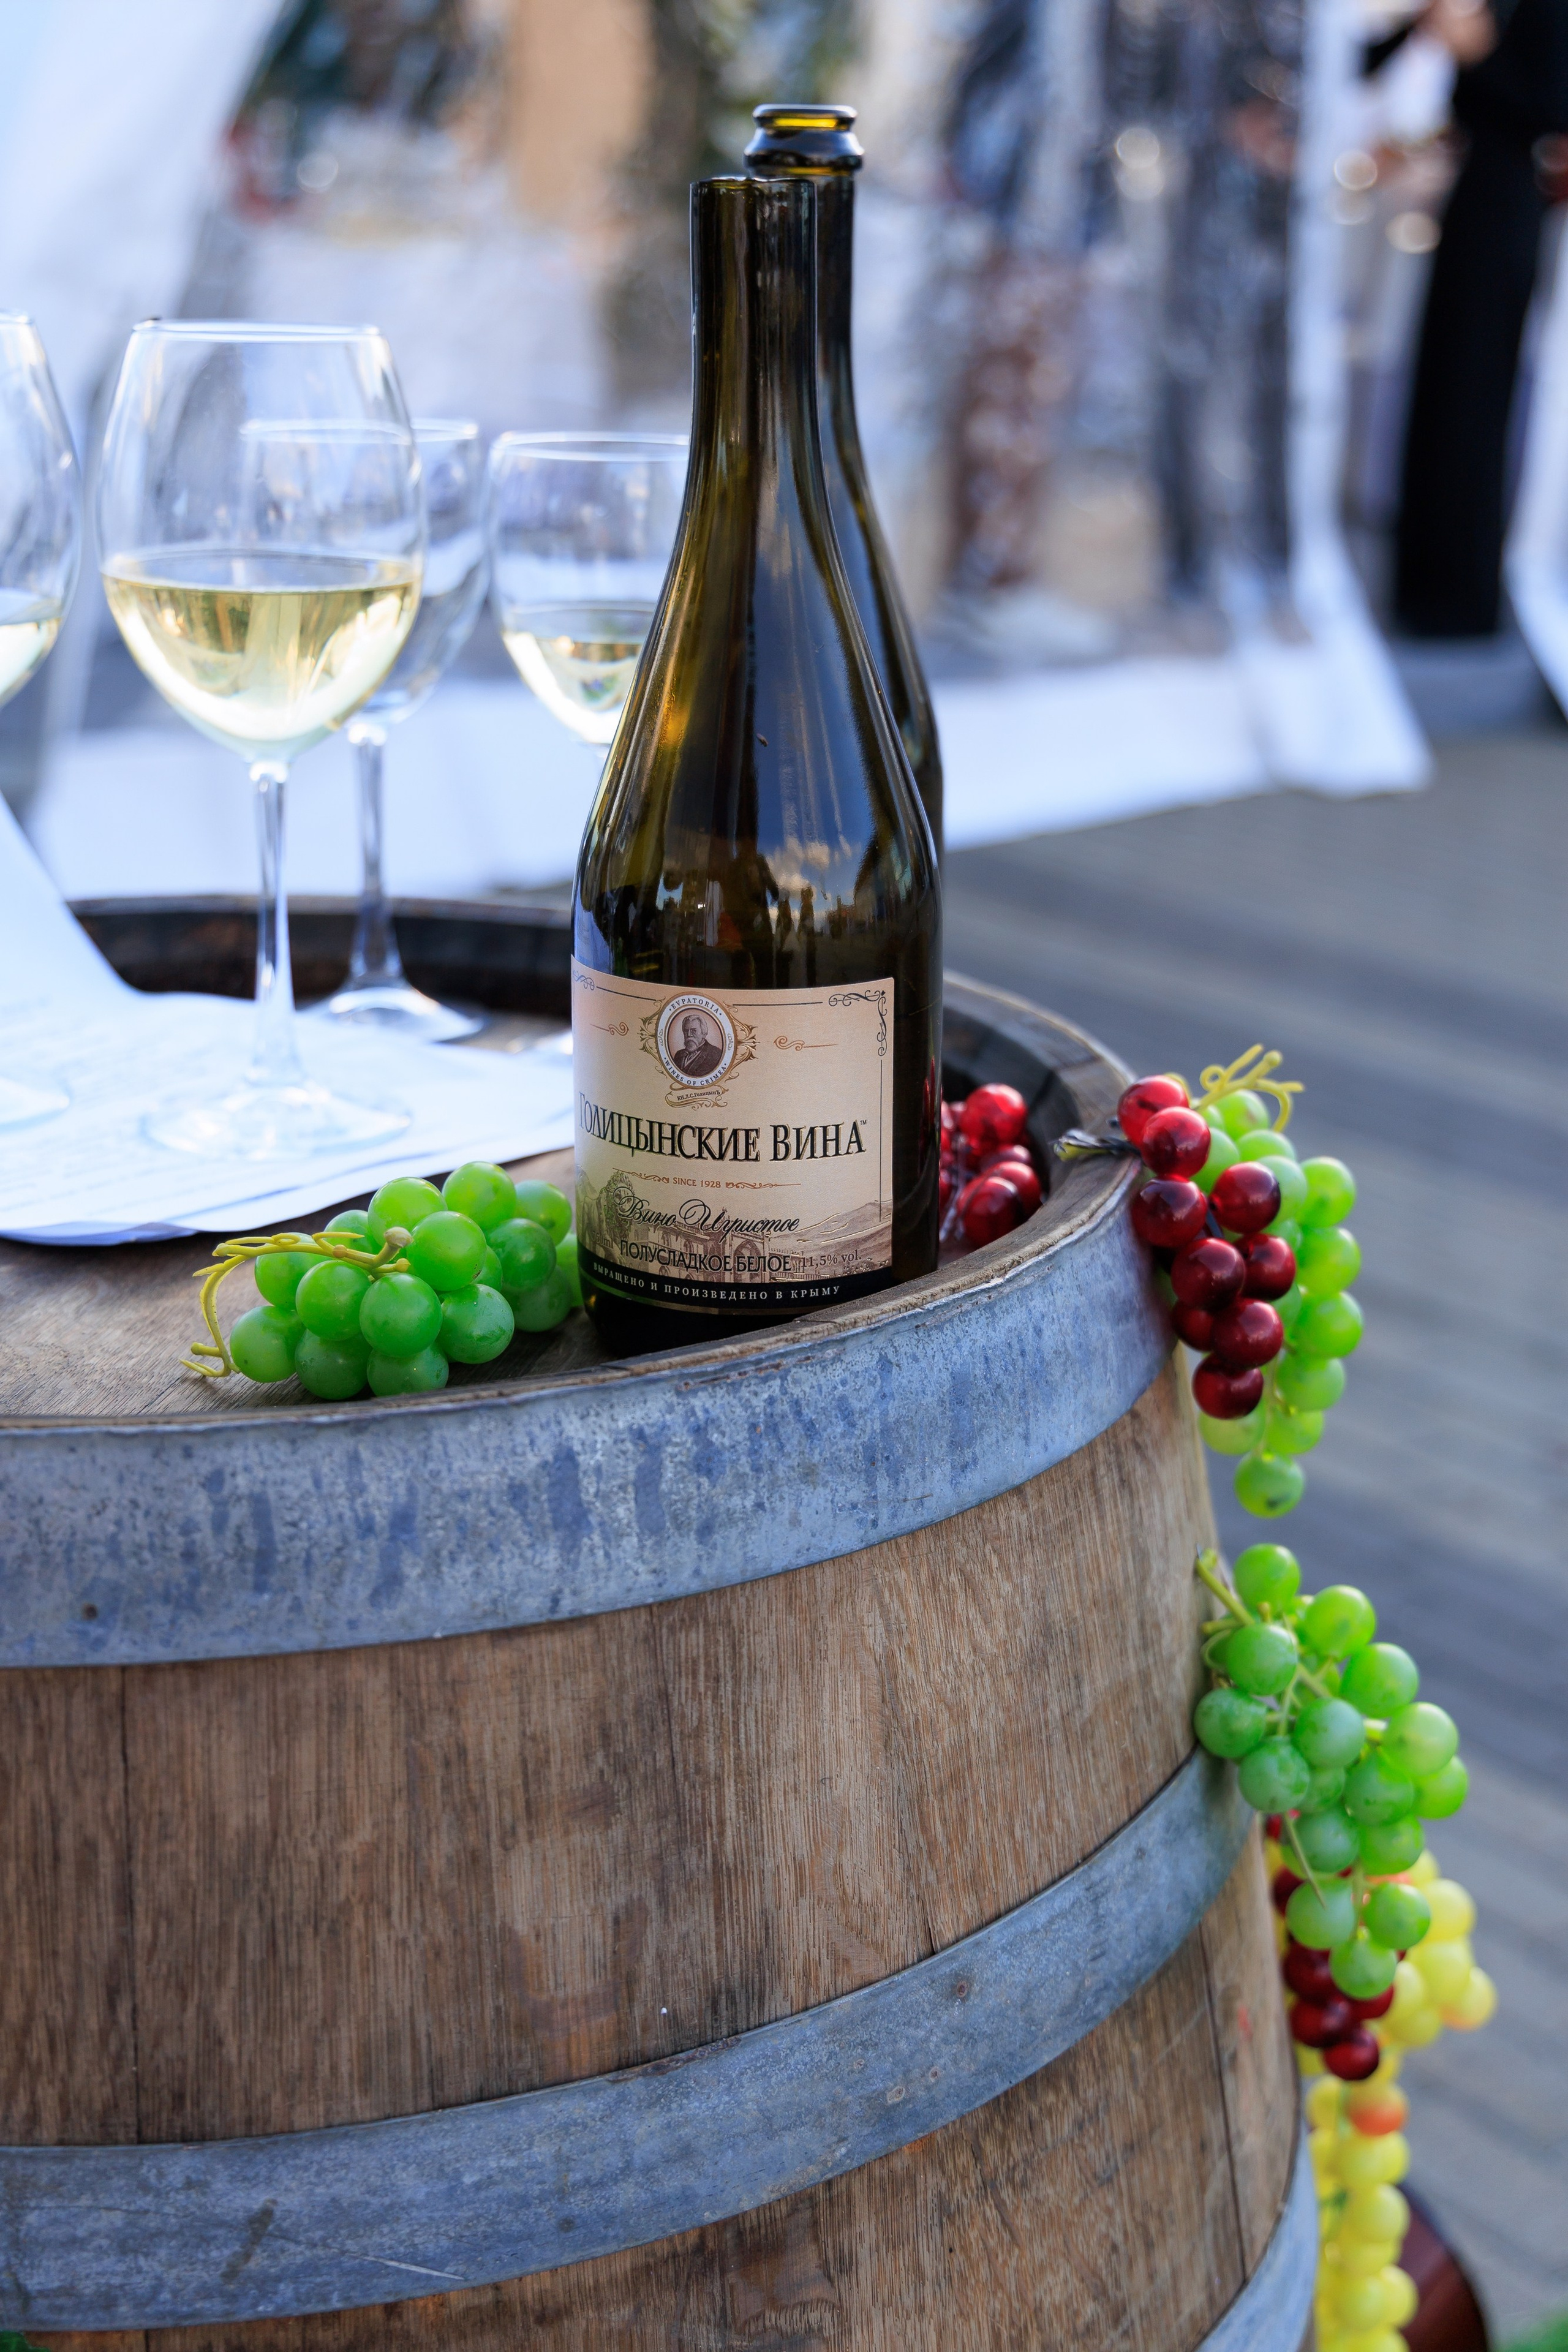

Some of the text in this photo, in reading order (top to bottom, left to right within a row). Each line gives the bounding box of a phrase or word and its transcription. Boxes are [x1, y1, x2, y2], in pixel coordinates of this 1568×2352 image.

[665, 1060, 684, 1082] WINES
[700, 1065, 727, 1086] CRIMEA
[769, 1120, 866, 1162] ВИНА
[673, 1177, 721, 1188] SINCE 1928
[620, 1240, 792, 1273] ПОЛУСЛАДКОЕ БЕЛОЕ
[801, 1250, 862, 1268] 11,5% vol.
[593, 1262, 645, 1287] ВЫРАЩЕНО
[650, 1282, 658, 1291] И
[665, 1284, 767, 1301] ПРОИЗВЕДЕНО
[791, 1286, 840, 1298] КРЫМУ
